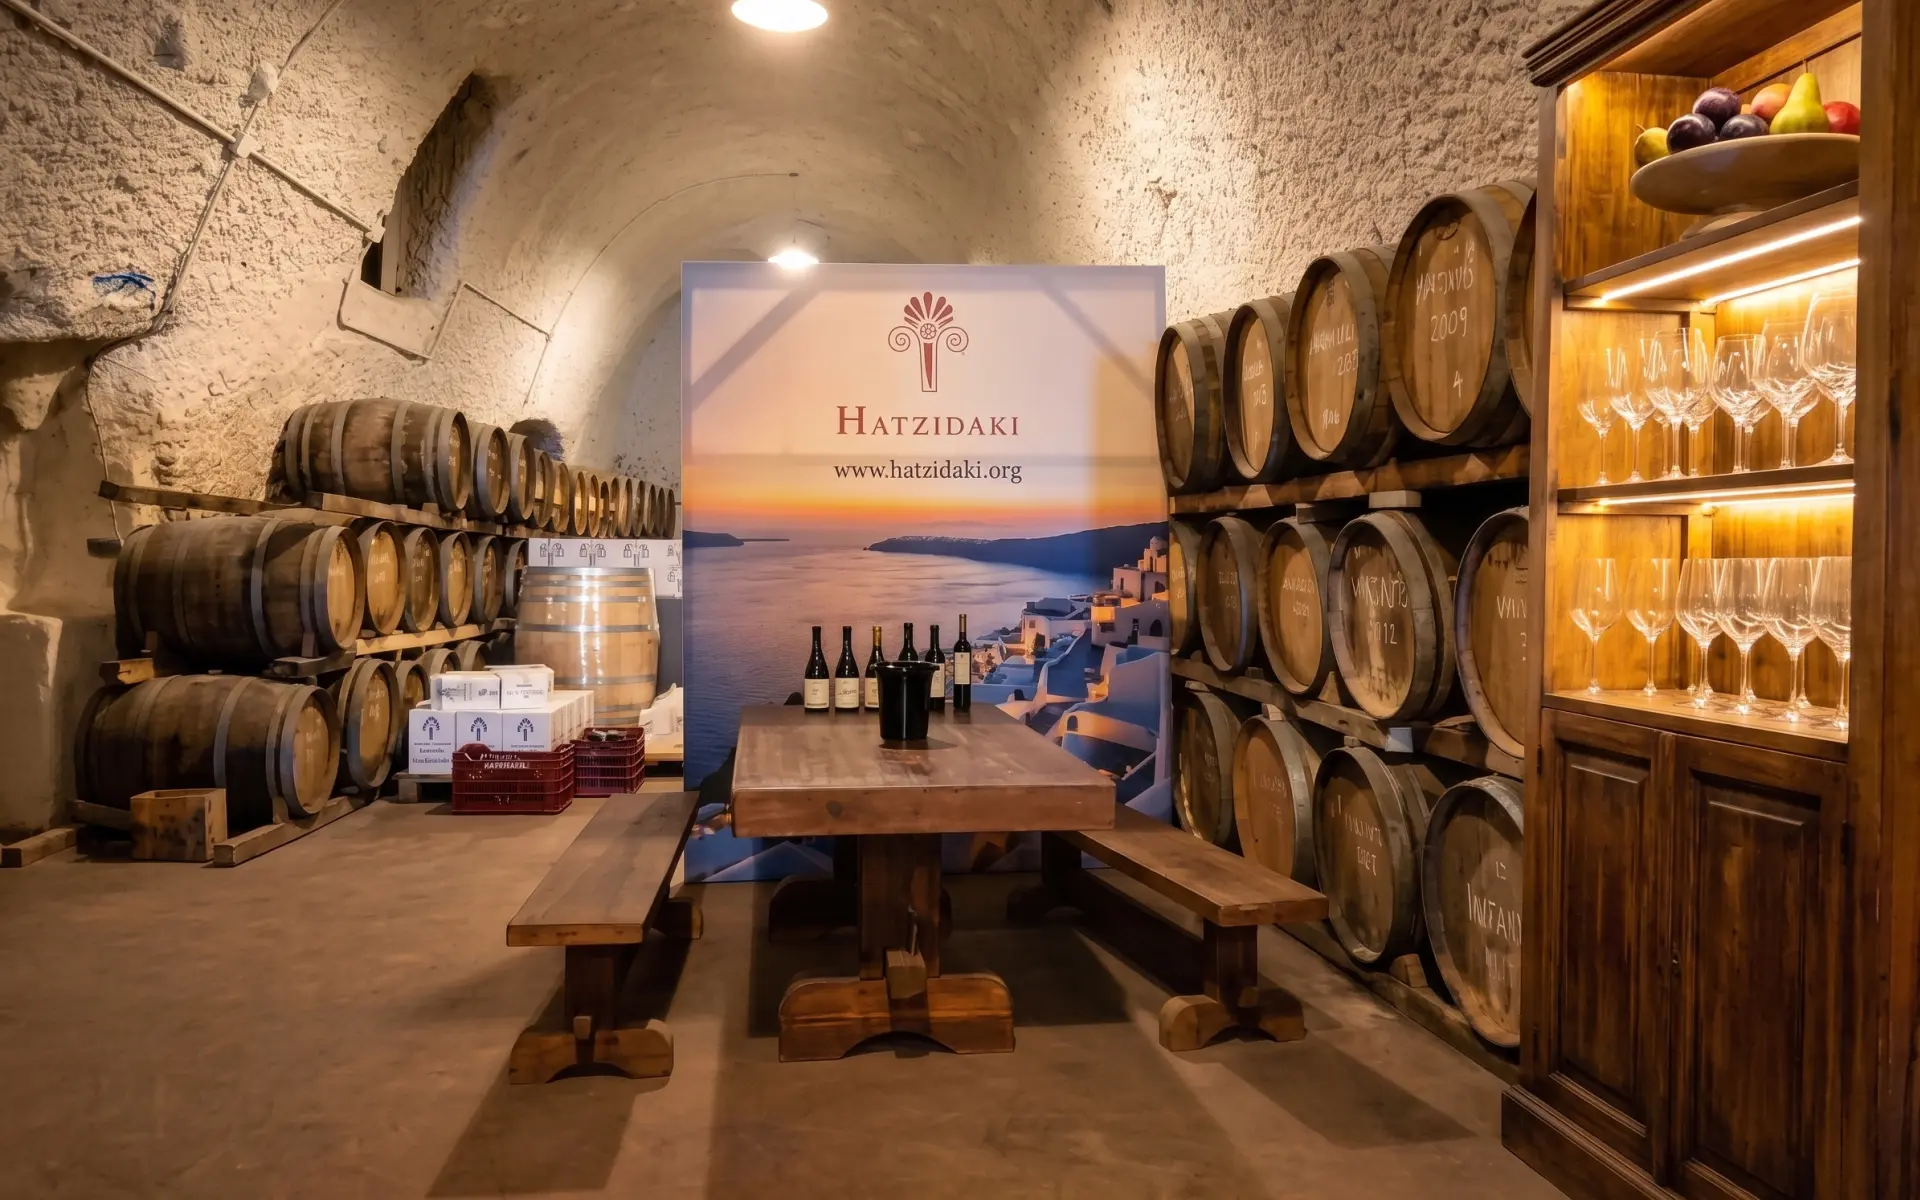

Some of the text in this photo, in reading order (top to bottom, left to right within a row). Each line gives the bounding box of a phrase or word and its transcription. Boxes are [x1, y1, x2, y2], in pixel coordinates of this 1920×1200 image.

[1430, 306, 1468, 342] 2009
[836, 405, 1020, 436] HATZIDAKI
[833, 459, 1022, 485] www.hatzidaki.org
